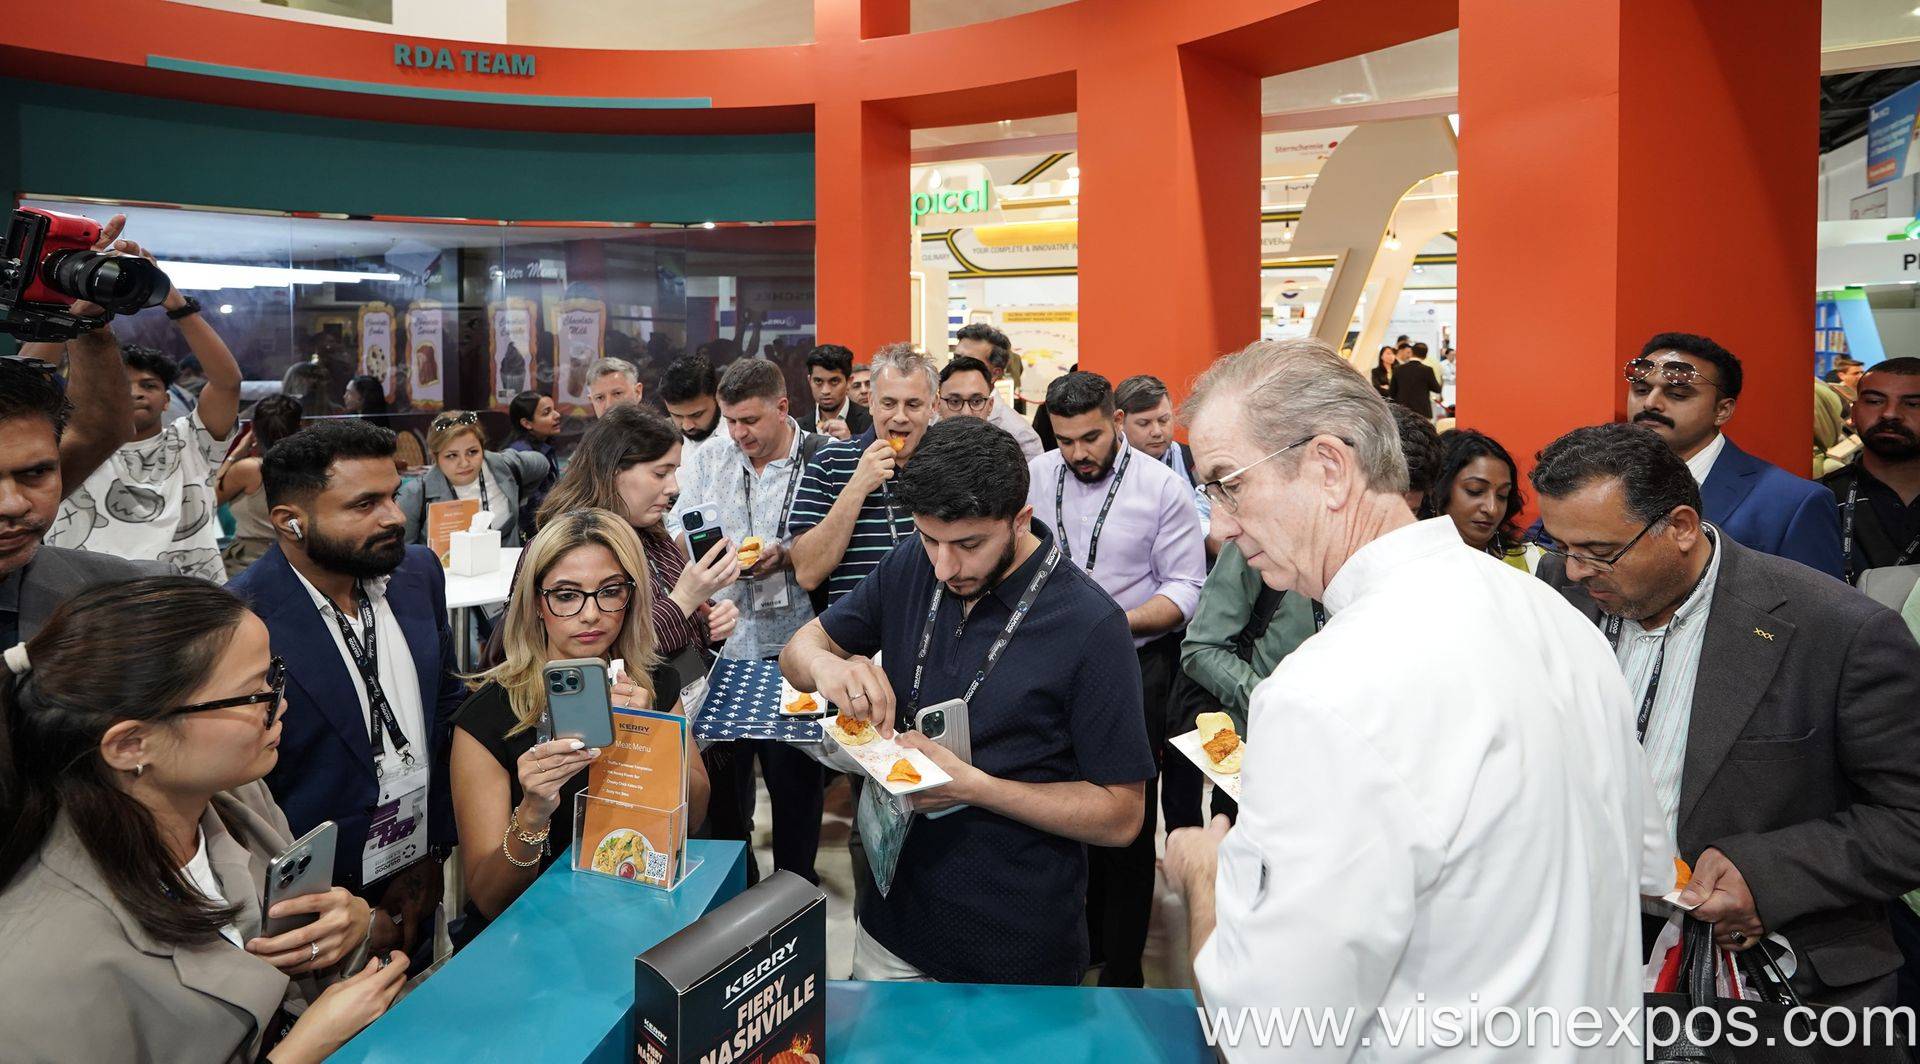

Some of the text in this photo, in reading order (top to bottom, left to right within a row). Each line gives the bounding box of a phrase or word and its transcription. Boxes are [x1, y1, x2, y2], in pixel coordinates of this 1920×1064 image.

[394, 43, 536, 76] RDA TEAM
[991, 246, 1023, 254] COMPLETE
[619, 722, 650, 733] KERRY
[632, 742, 651, 753] Menu
[724, 935, 798, 1001] KERRY
[700, 972, 816, 1064] NASHVILLE
[737, 974, 786, 1030] FIERY
